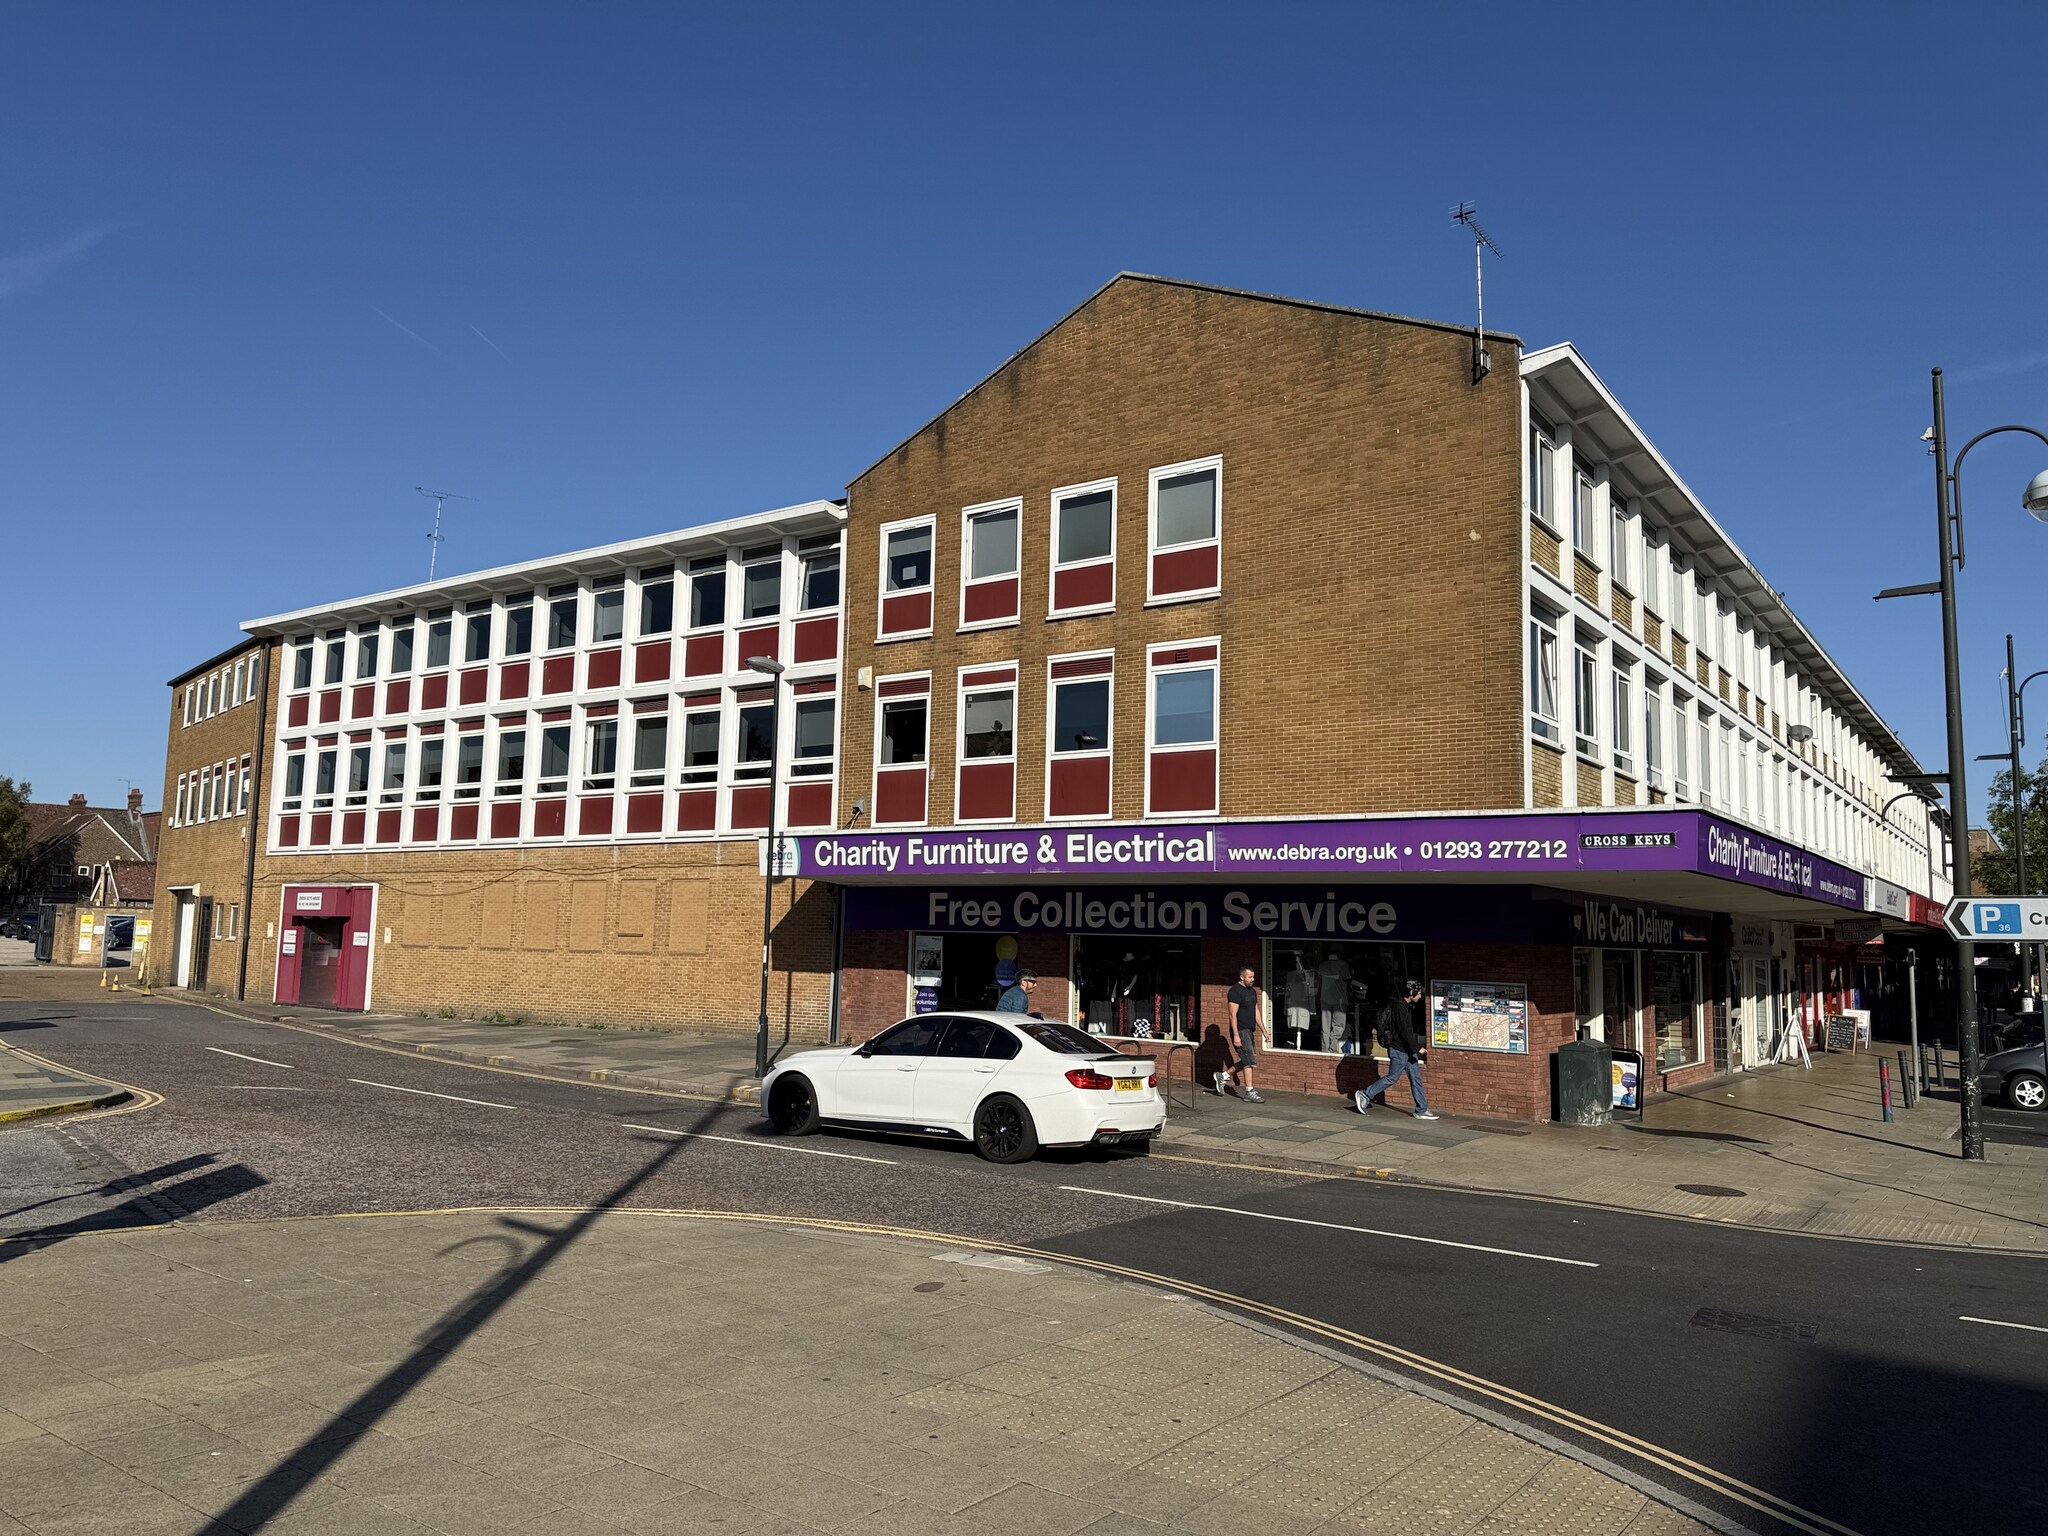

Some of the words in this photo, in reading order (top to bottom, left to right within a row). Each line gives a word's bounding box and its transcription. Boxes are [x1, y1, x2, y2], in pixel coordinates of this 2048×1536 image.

[814, 839, 900, 872] Charity
[907, 836, 1029, 865] Furniture
[1036, 834, 1058, 864] &
[1066, 830, 1214, 863] Electrical
[1228, 842, 1398, 864] www.debra.org.uk
[1420, 840, 1483, 859] 01293
[1488, 839, 1568, 859] 277212
[1585, 835, 1627, 846] CROSS
[1634, 834, 1672, 845] KEYS
[1708, 825, 1743, 876] Charity
[1743, 837, 1777, 879] Furniture
[1777, 850, 1783, 880] &
[1783, 851, 1813, 888] Electical
[929, 892, 1002, 926] Free
[1013, 891, 1208, 930] Collection
[1222, 891, 1397, 933] Service
[1584, 900, 1606, 942] We
[1609, 903, 1634, 943] Can
[1636, 906, 1675, 945] Deliver
[1980, 906, 2001, 931] P
